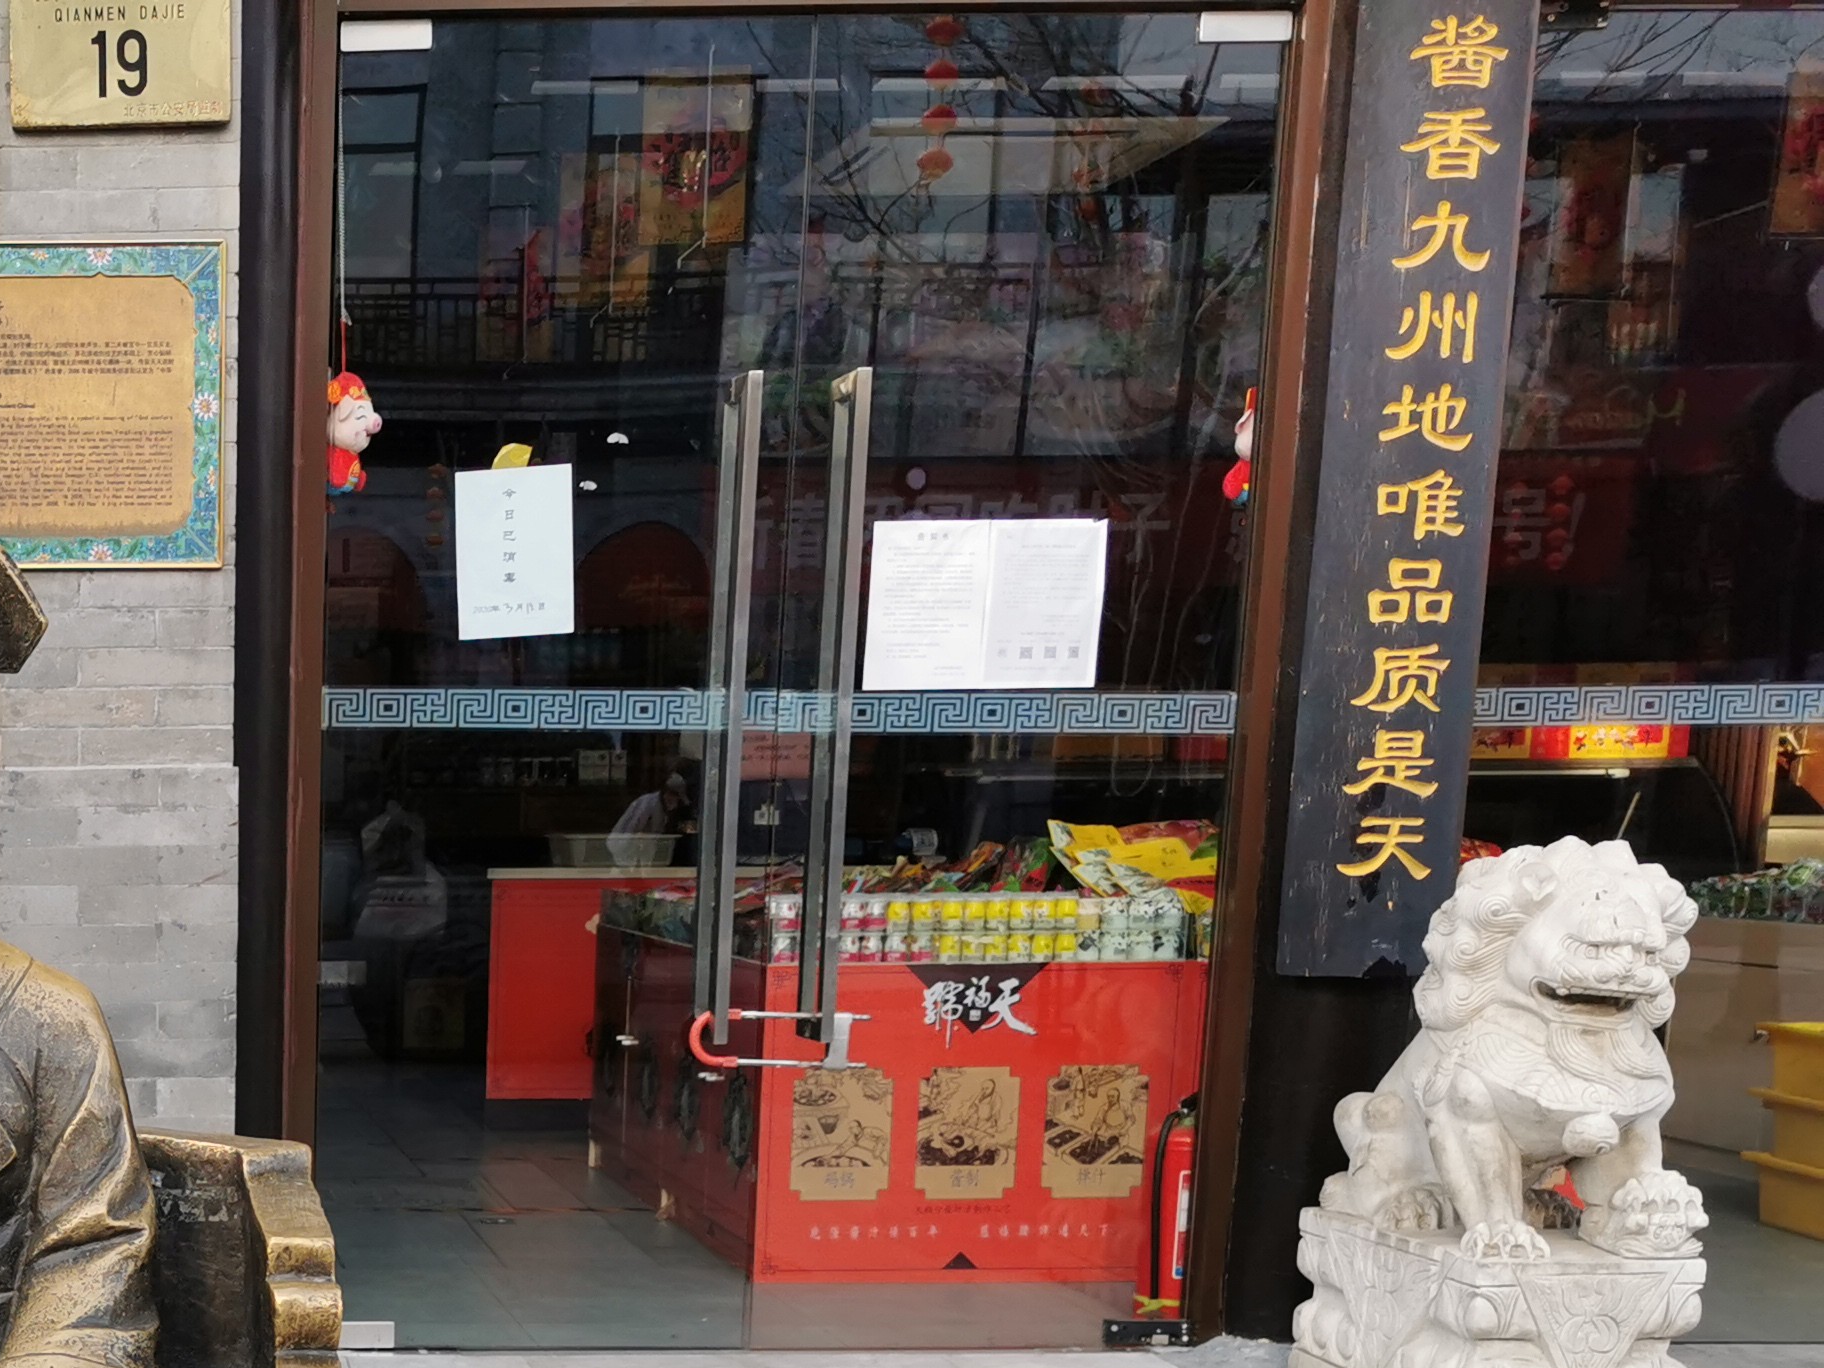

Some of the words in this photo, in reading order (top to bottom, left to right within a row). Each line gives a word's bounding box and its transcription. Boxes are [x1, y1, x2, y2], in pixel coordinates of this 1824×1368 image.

[54, 6, 126, 23] QIANMEN
[139, 4, 185, 21] DAJIE
[90, 28, 148, 99] 19
[1336, 14, 1510, 882] 酱香九州地唯品质是天
